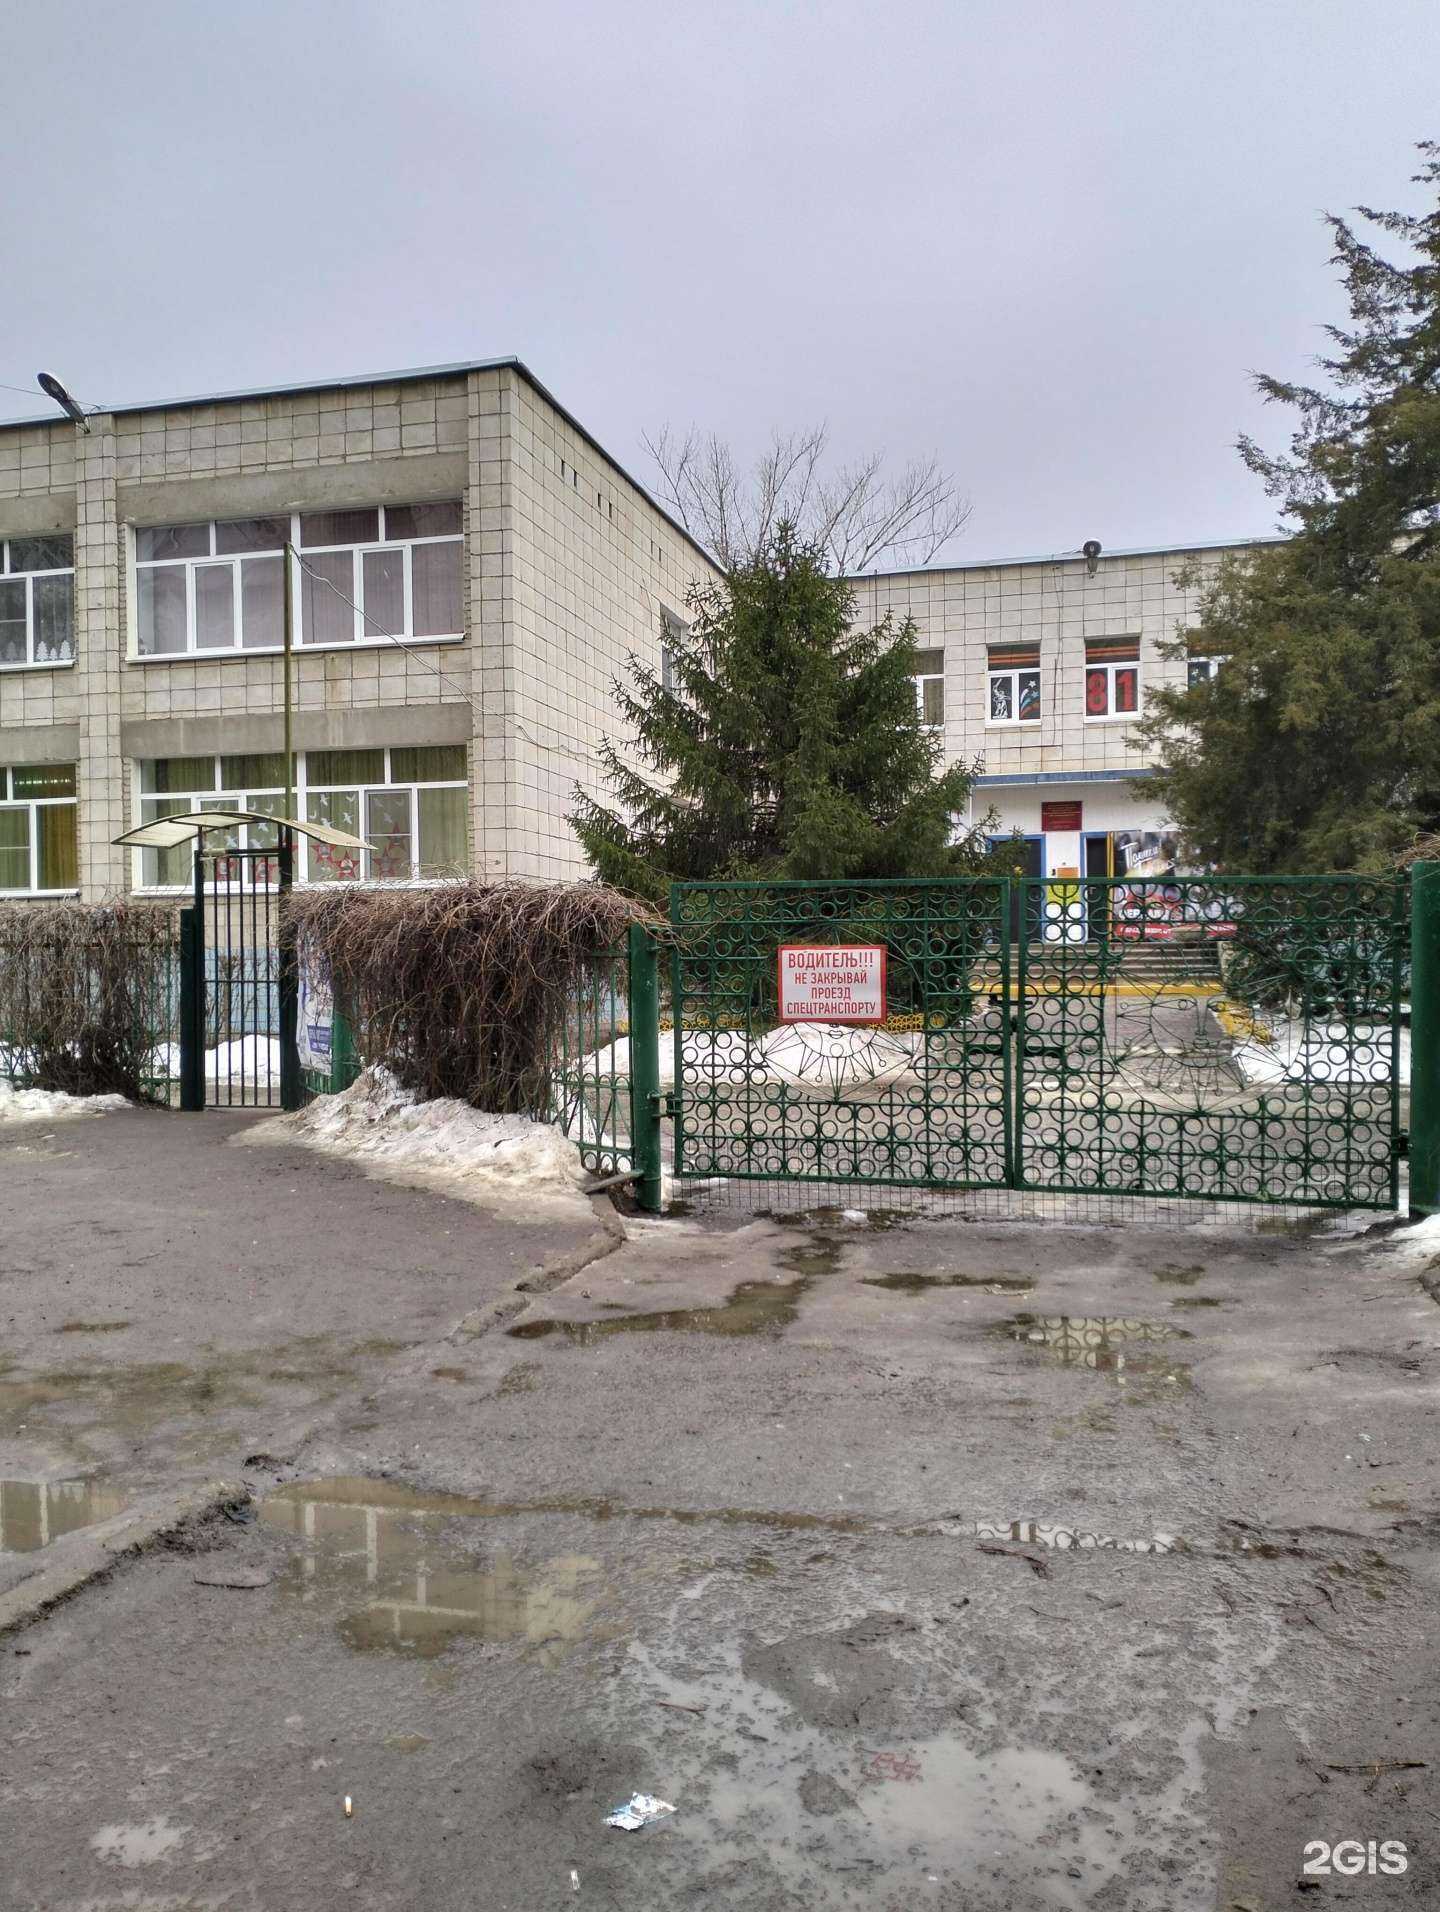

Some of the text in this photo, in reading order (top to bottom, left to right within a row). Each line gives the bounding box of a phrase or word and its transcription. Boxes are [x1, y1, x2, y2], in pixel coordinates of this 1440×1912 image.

[1086, 671, 1133, 713] 81
[788, 952, 873, 970] ВОДИТЕЛЬ!!!
[795, 970, 867, 984] НЕ ЗАКРЫВАЙ
[811, 987, 851, 1000] ПРОЕЗД
[787, 1002, 876, 1015] СПЕЦТРАНСПОРТУ
